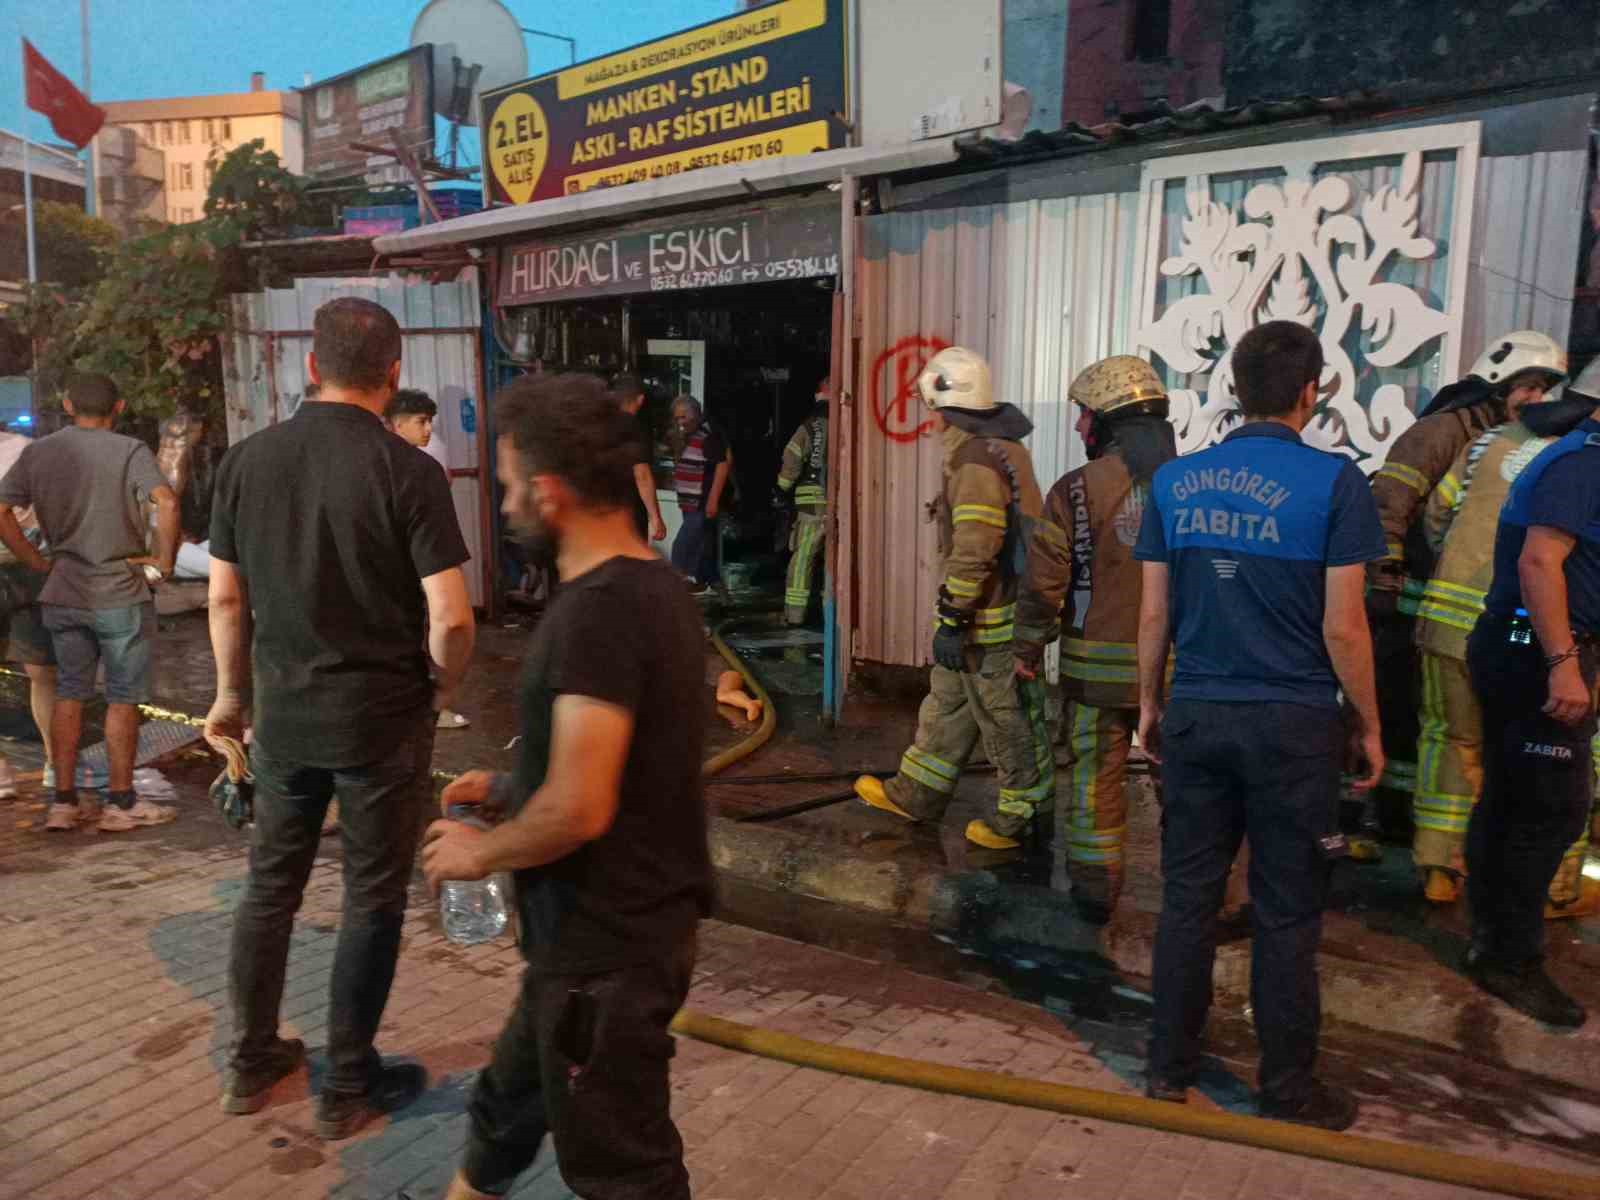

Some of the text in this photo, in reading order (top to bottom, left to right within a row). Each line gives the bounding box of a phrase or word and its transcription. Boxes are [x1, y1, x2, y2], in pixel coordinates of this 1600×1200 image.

[584, 65, 628, 85] MAĞAZA
[640, 37, 716, 68] DEKORASYON
[585, 80, 677, 126] MANKEN
[690, 56, 768, 98] STAND
[571, 132, 616, 165] ASKI
[629, 119, 671, 151] RAF
[672, 76, 812, 139] SİSTEMLERİ
[721, 145, 745, 164] 647
[747, 142, 762, 159] 70
[765, 138, 784, 155] 60
[511, 239, 619, 295] HURDACI
[649, 221, 750, 273] ESKİCİ
[1172, 466, 1292, 511] GÜNGÖREN
[1173, 507, 1280, 544] ZABITA
[1524, 742, 1572, 759] ZABITA
